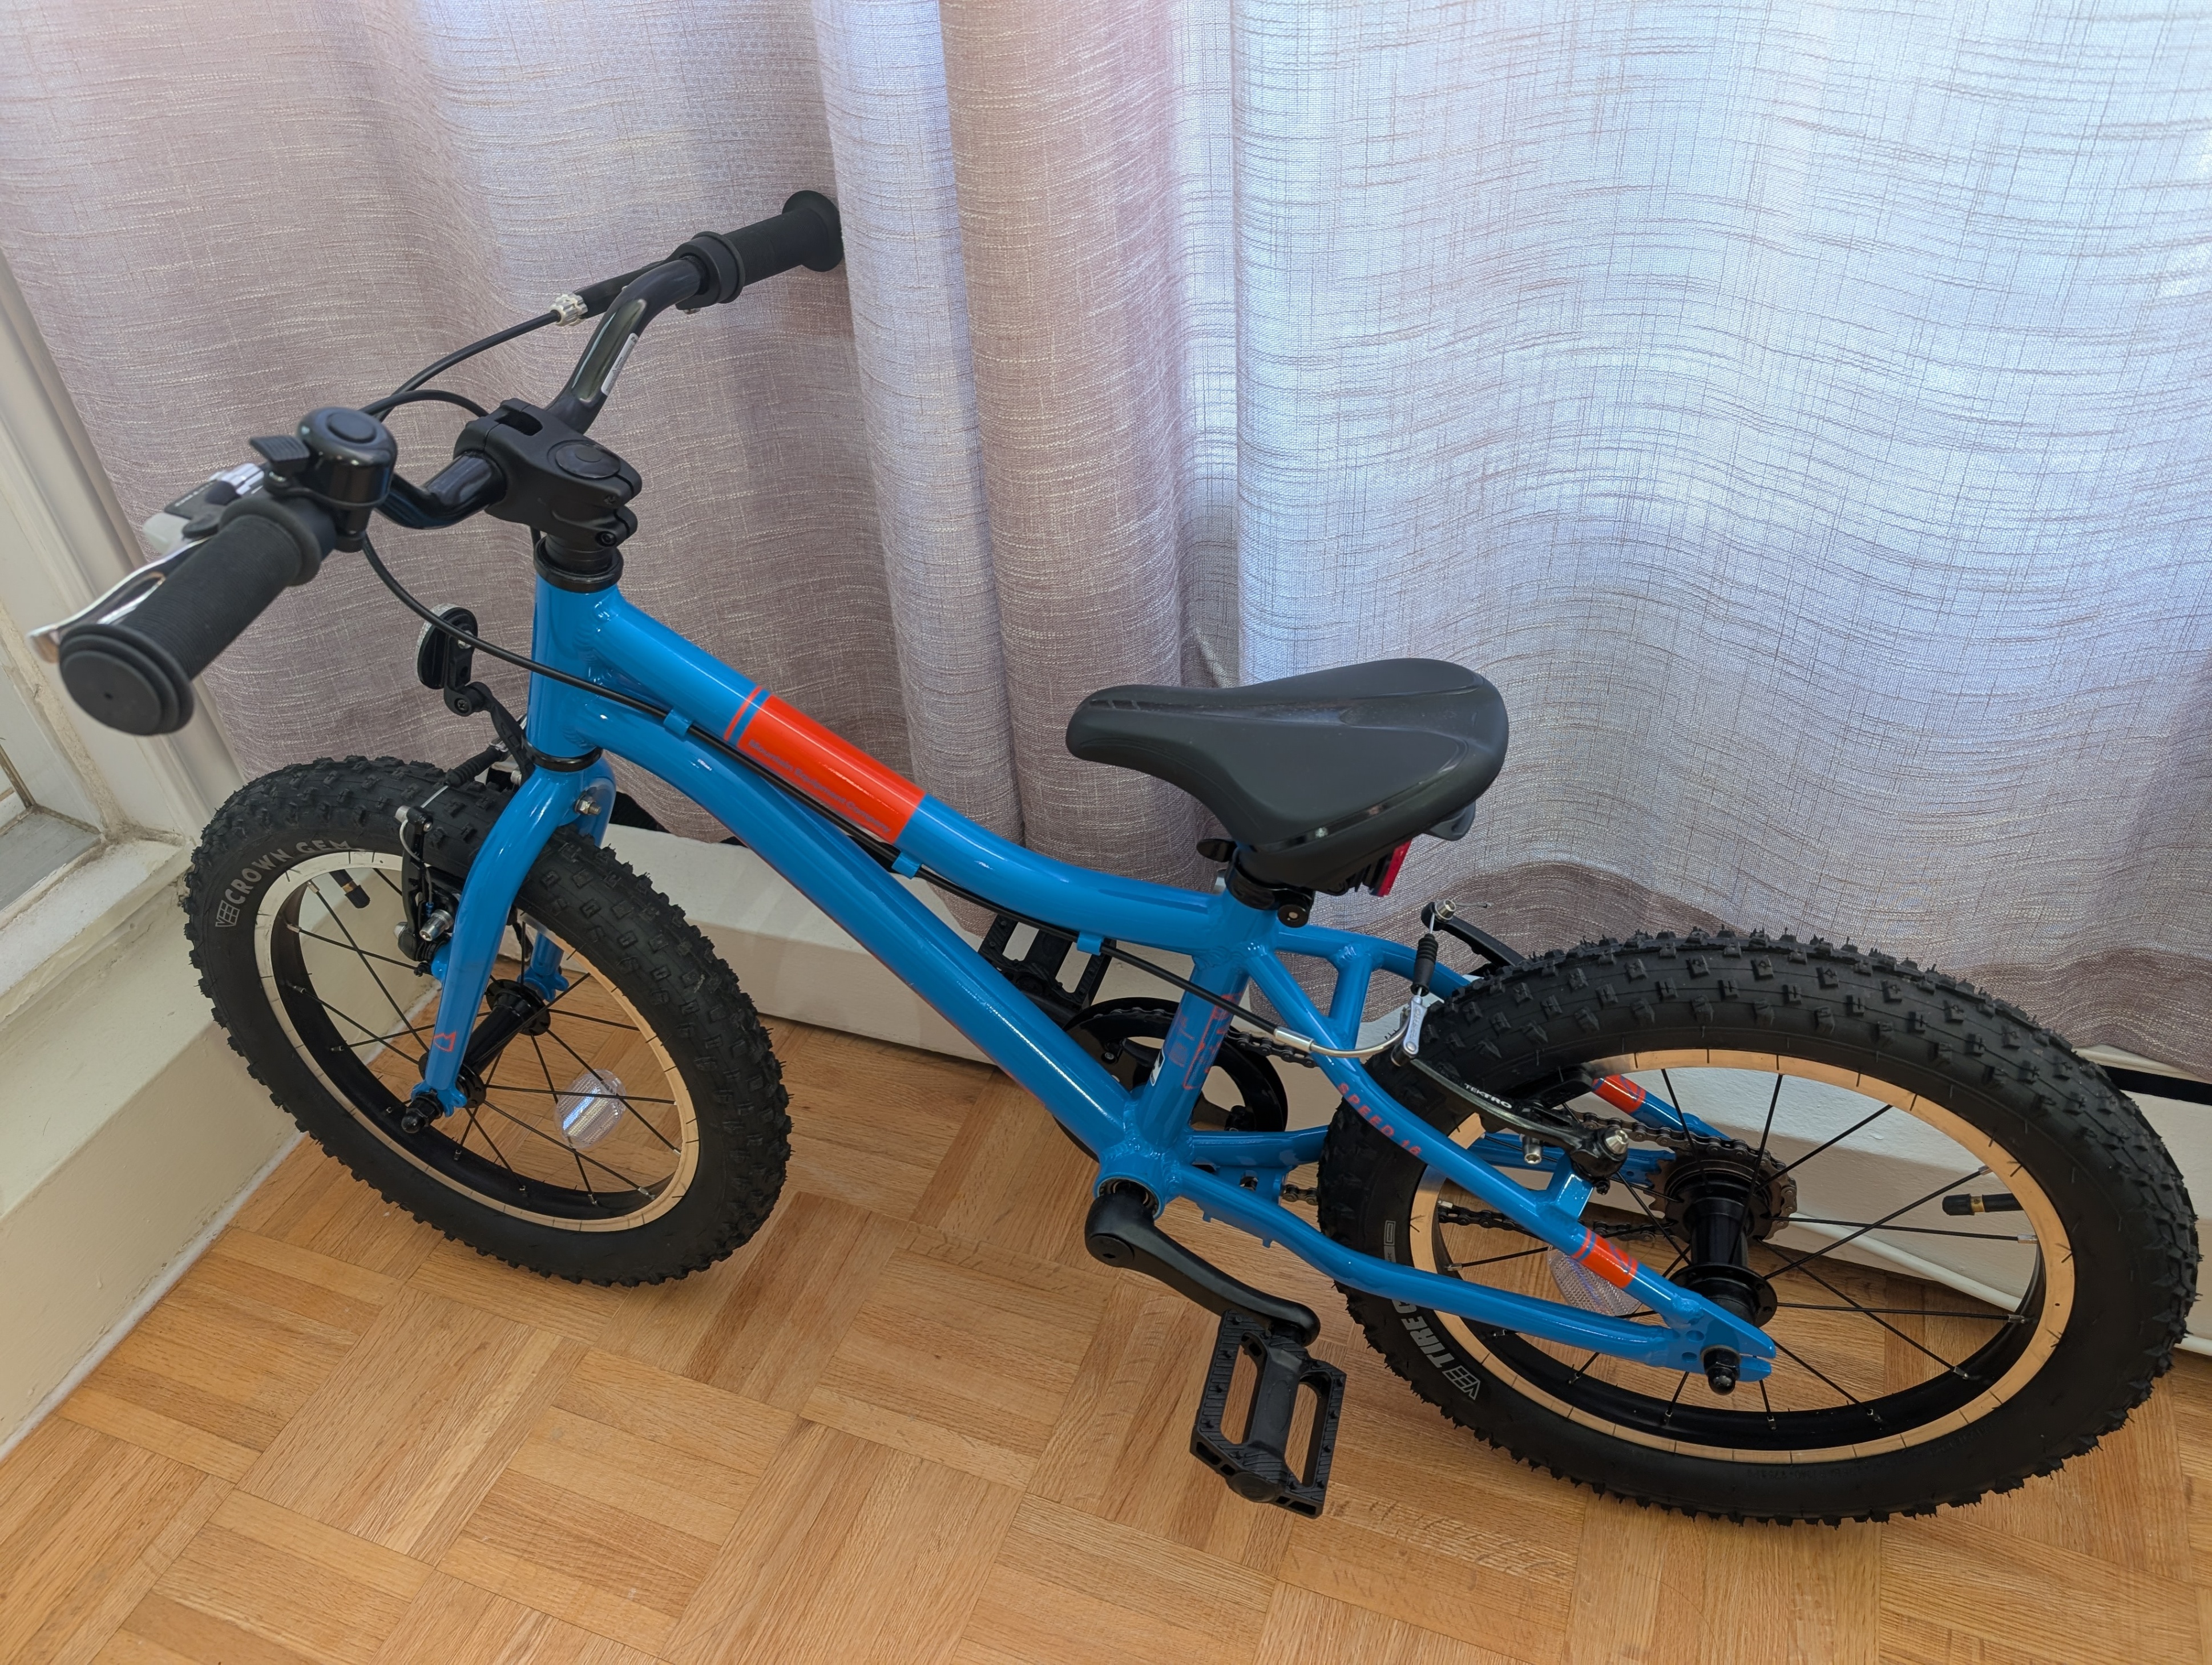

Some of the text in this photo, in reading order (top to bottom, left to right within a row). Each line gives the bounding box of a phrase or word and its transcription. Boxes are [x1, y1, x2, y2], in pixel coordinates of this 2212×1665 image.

[749, 739, 891, 833] Mountain Equipment Company
[225, 848, 293, 904] CROWN
[296, 840, 352, 853] GEM
[1338, 1082, 1422, 1156] SPEED 16
[1464, 1082, 1512, 1109] TEKTRO
[1401, 1316, 1455, 1368] TIRE
